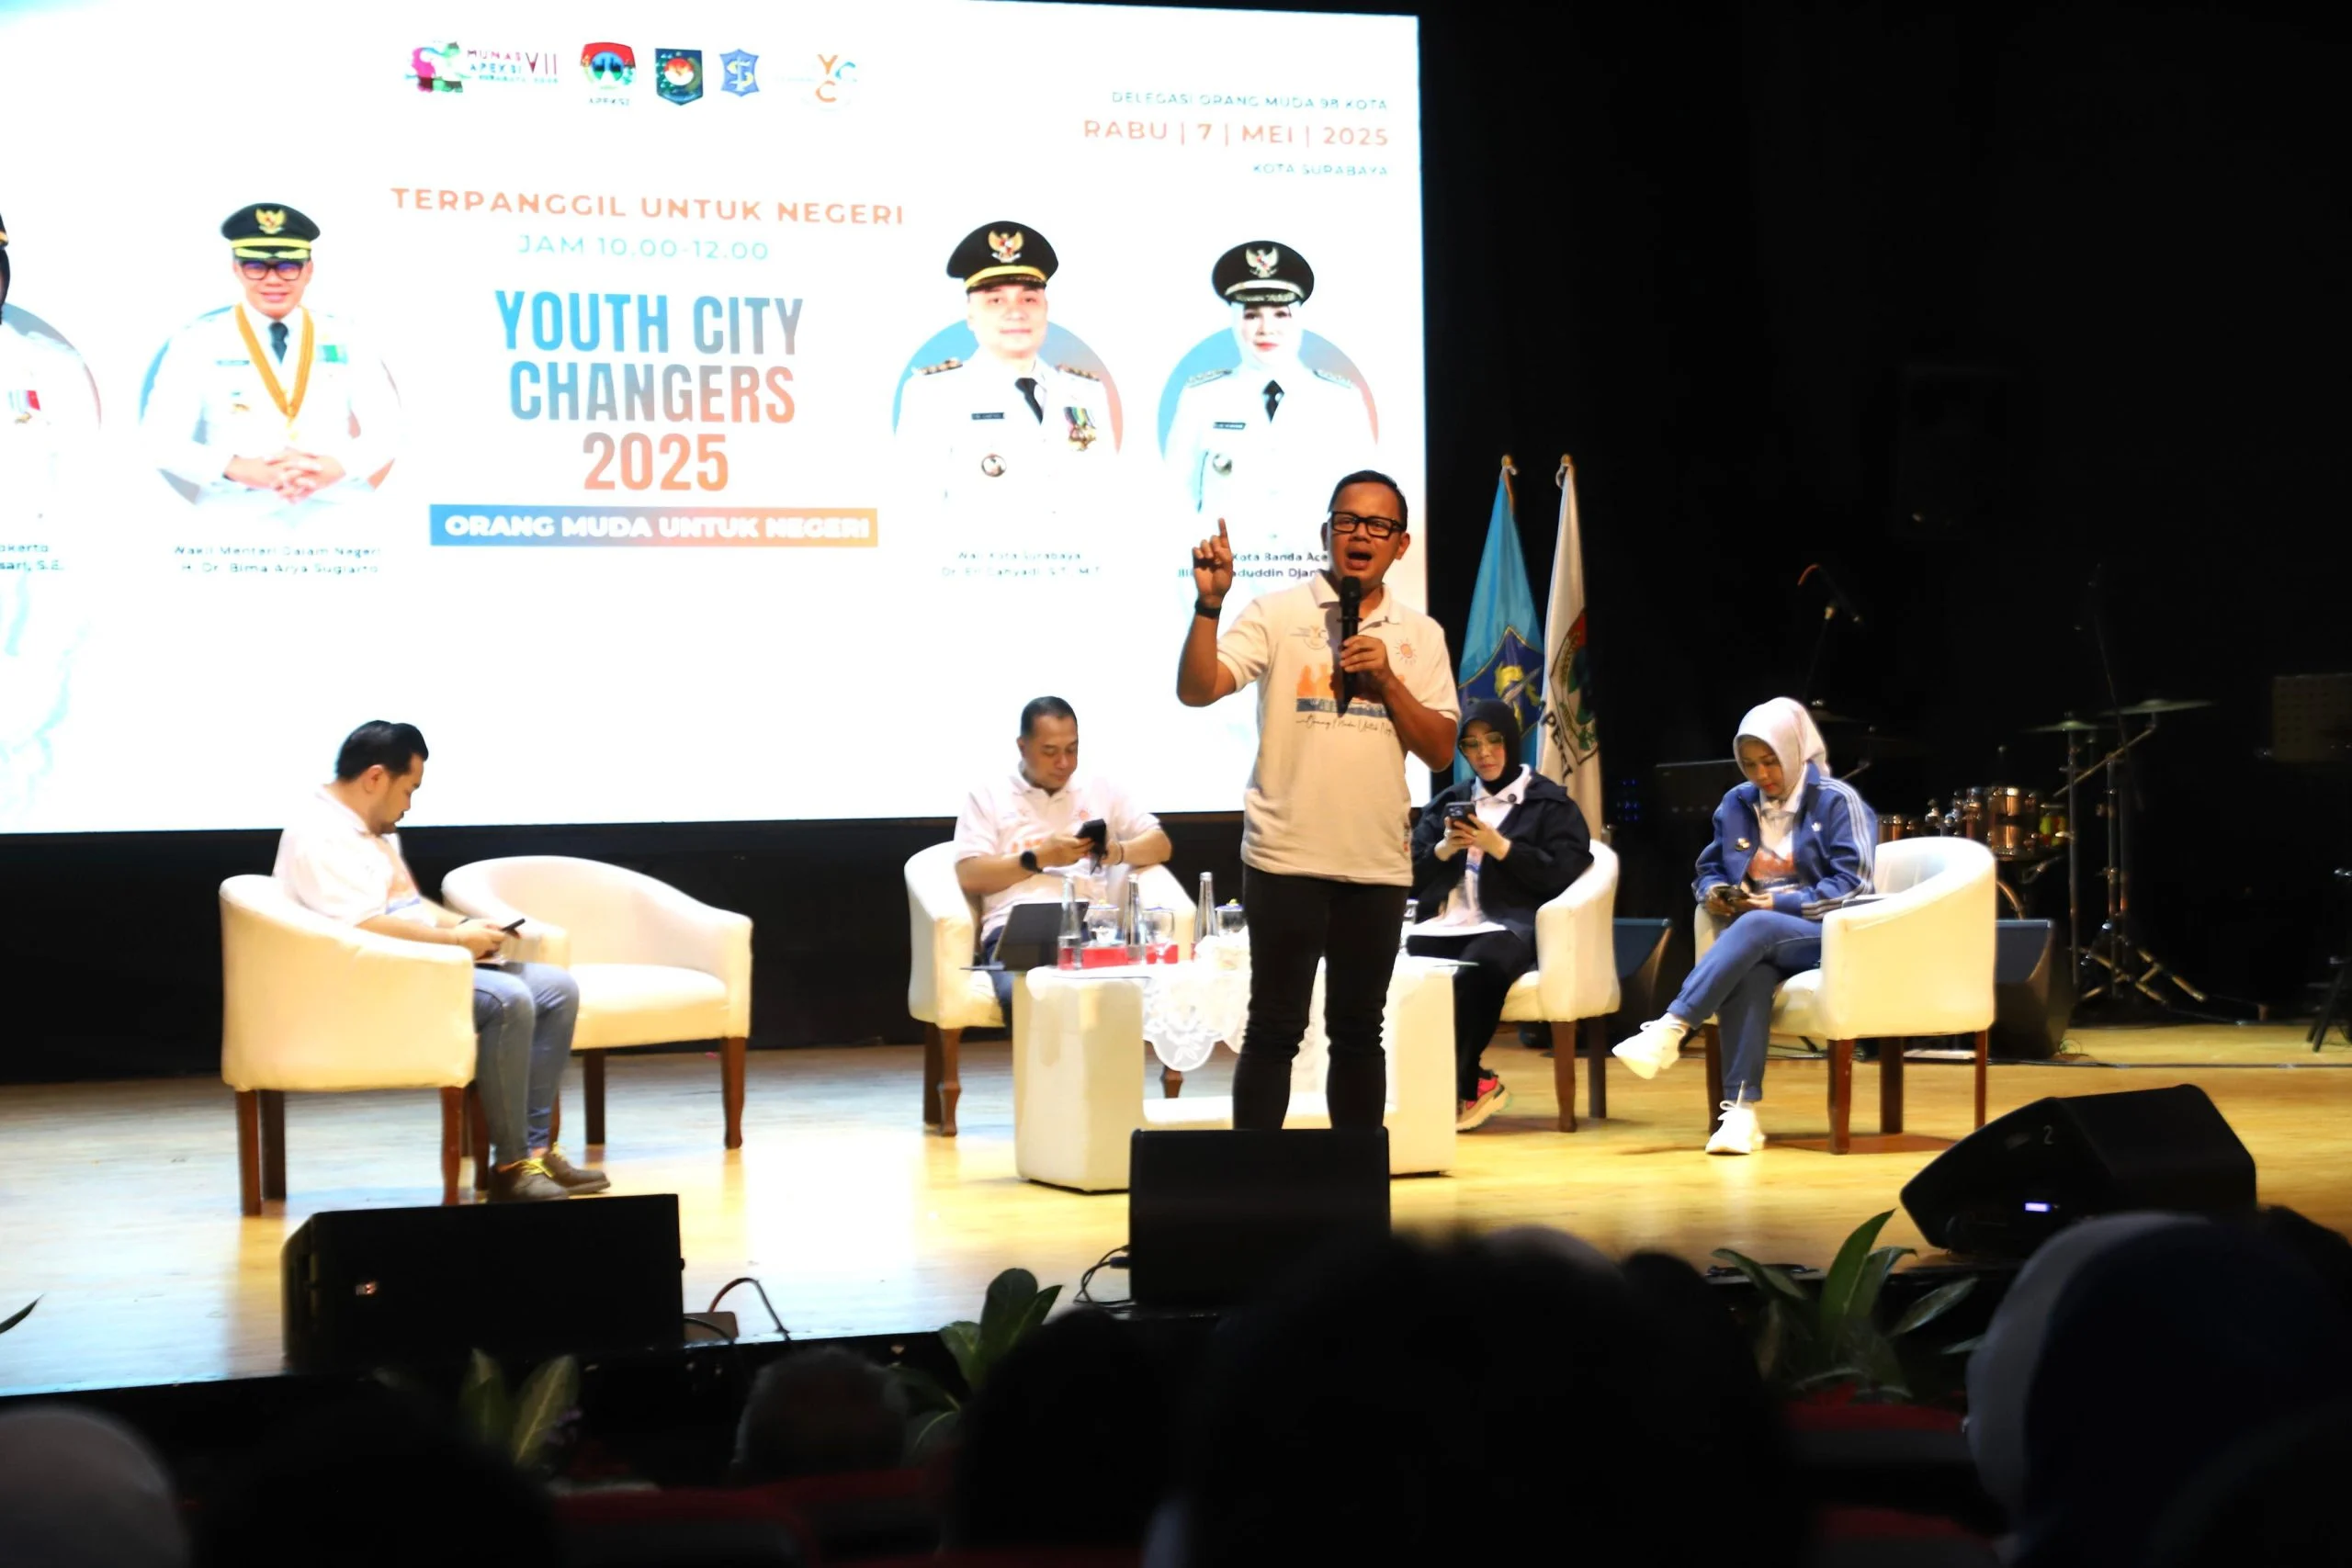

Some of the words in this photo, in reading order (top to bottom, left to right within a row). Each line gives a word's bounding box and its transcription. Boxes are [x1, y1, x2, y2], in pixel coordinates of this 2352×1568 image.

[1112, 90, 1193, 106] DELEGASI
[1198, 94, 1261, 108] ORANG
[1263, 95, 1316, 109] MUDA
[1344, 97, 1387, 112] KOTA
[1083, 118, 1168, 141] RABU
[1196, 122, 1213, 141] 7
[1241, 124, 1294, 144] MEI
[1323, 126, 1389, 147] 2025
[1252, 163, 1295, 175] KOTA
[390, 186, 628, 218] TERPANGGIL
[639, 196, 762, 221] UNTUK
[776, 201, 903, 226] NEGERI
[517, 232, 585, 255] JAM
[493, 288, 670, 354] YOUTH
[692, 295, 804, 355] CITY
[510, 359, 796, 424] CHANGERS
[582, 432, 729, 492] 2025
[445, 515, 555, 538] ORANG
[561, 516, 653, 539] MUDA
[660, 517, 759, 540] UNTUK
[764, 518, 869, 541] NEGERI
[1264, 552, 1304, 561] Banda
[2043, 1125, 2054, 1145] 2
